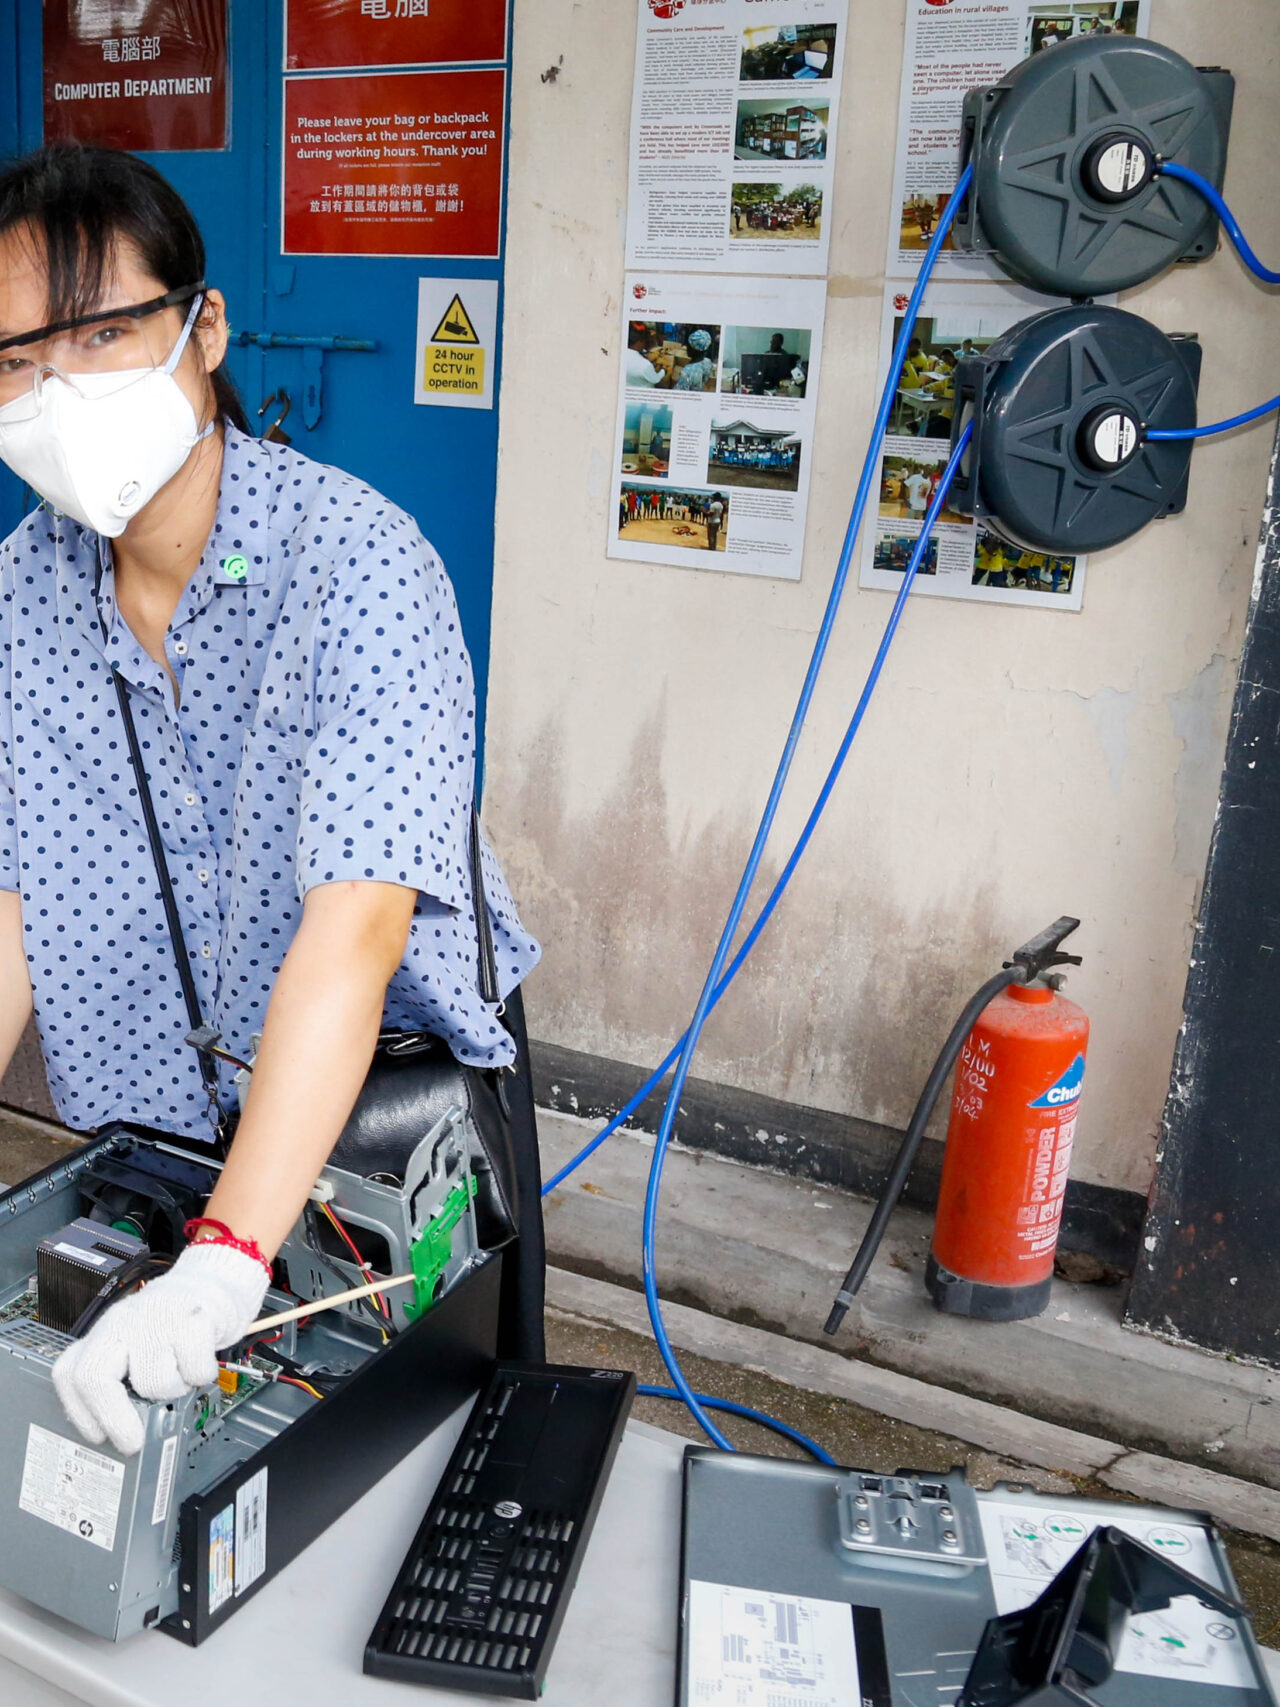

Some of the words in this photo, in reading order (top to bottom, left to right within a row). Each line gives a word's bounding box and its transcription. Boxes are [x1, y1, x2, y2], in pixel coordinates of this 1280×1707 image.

[982, 5, 1008, 13] villages
[102, 36, 160, 62] 電腦部
[55, 82, 120, 100] COMPUTER
[124, 77, 212, 97] DEPARTMENT
[298, 118, 331, 128] Please
[334, 116, 362, 126] leave
[365, 118, 391, 128] your
[394, 114, 415, 127] bag
[418, 116, 431, 124] or
[434, 112, 489, 125] backpack
[290, 132, 301, 143] in
[304, 132, 321, 143] the
[324, 132, 363, 142] lockers
[366, 132, 377, 141] at
[380, 130, 398, 141] the
[402, 130, 467, 140] undercover
[470, 130, 496, 140] area
[297, 148, 332, 160] during
[336, 147, 380, 159] working
[384, 146, 418, 156] hours.
[422, 145, 458, 156] Thank
[461, 144, 487, 158] you!
[322, 184, 458, 197] 工作期間請將你的背包或袋
[435, 349, 446, 360] 24
[451, 350, 474, 360] hour
[433, 363, 462, 374] CCTV
[466, 365, 475, 374] in
[429, 379, 478, 390] operation
[1030, 1127, 1056, 1202] POWDER
[590, 1370, 624, 1379] Z220
[494, 1501, 523, 1518] hp
